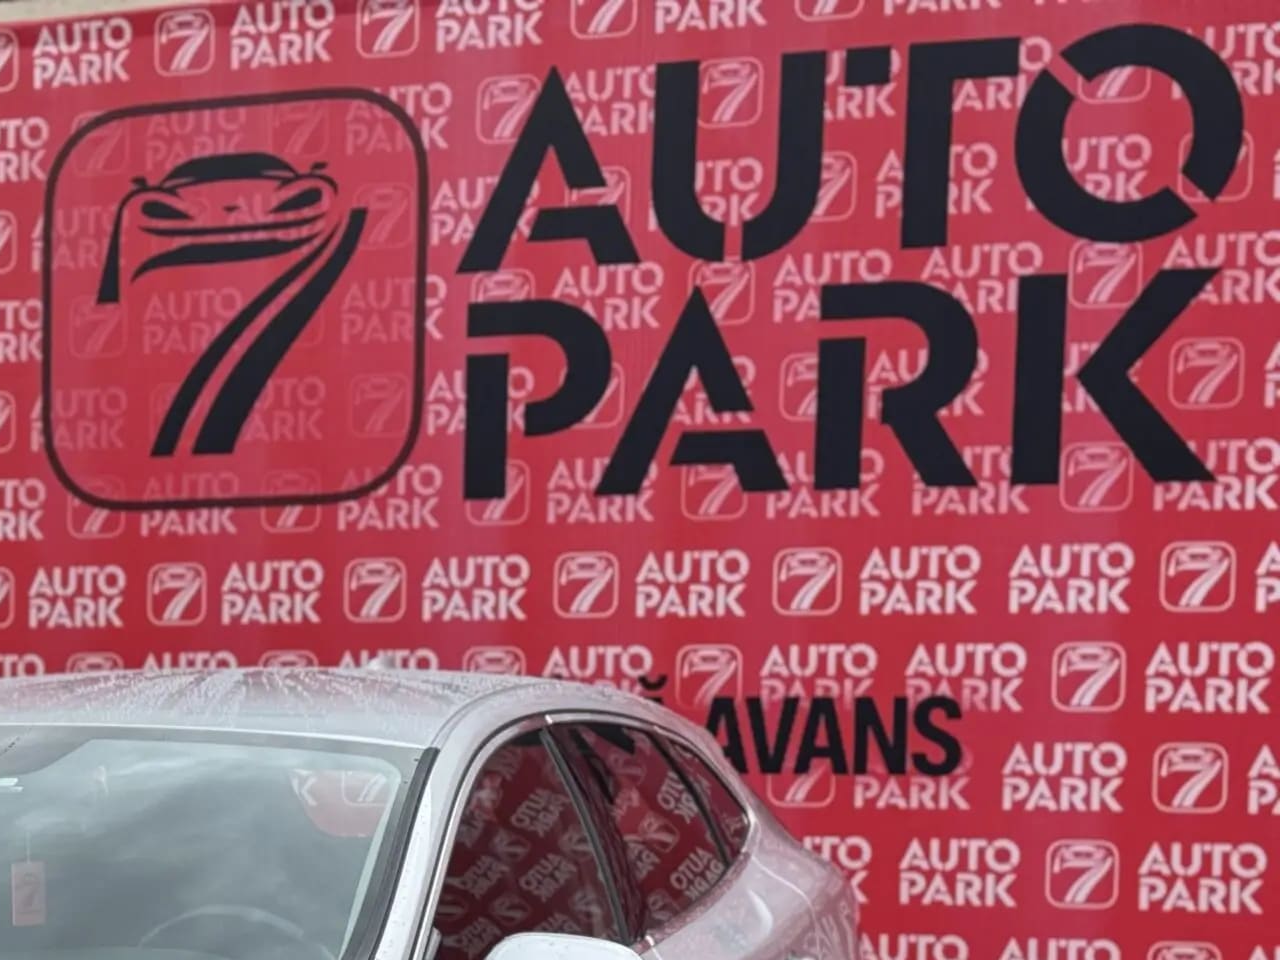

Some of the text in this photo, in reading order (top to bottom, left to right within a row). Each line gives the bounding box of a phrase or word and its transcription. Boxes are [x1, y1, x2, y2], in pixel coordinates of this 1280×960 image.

[230, 0, 335, 37] AUTO
[436, 11, 542, 52] PARK
[32, 18, 132, 56] AUTO
[231, 28, 331, 69] PARK
[33, 50, 130, 89] PARK
[455, 23, 1244, 273] AUTO
[774, 249, 892, 287] AUTO
[920, 242, 1043, 281] AUTO
[552, 261, 664, 299] AUTO
[463, 267, 1220, 500] PARK
[338, 497, 438, 531] PARK
[547, 489, 654, 523] PARK
[766, 485, 879, 519] PARK
[222, 559, 323, 592] AUTO
[422, 555, 530, 588] AUTO
[636, 549, 749, 584] AUTO
[860, 545, 981, 580] AUTO
[1010, 542, 1134, 578] AUTO
[29, 565, 126, 597] AUTO
[860, 580, 976, 615] PARK
[1009, 576, 1129, 613] PARK
[29, 596, 122, 628] PARK
[222, 591, 320, 624] PARK
[422, 587, 526, 621] PARK
[636, 583, 745, 617] PARK
[542, 645, 653, 679] AUTO
[760, 643, 877, 677] AUTO
[906, 643, 1027, 677] AUTO
[1146, 642, 1274, 677] AUTO
[1145, 677, 1269, 713] PARK
[703, 695, 963, 777] AVANS
[1003, 742, 1127, 777] AUTO
[854, 775, 970, 811] PARK
[1002, 777, 1122, 812] PARK
[900, 838, 1020, 872] AUTO
[1139, 843, 1267, 878] AUTO
[900, 871, 1015, 907] PARK
[1139, 876, 1262, 914] PARK
